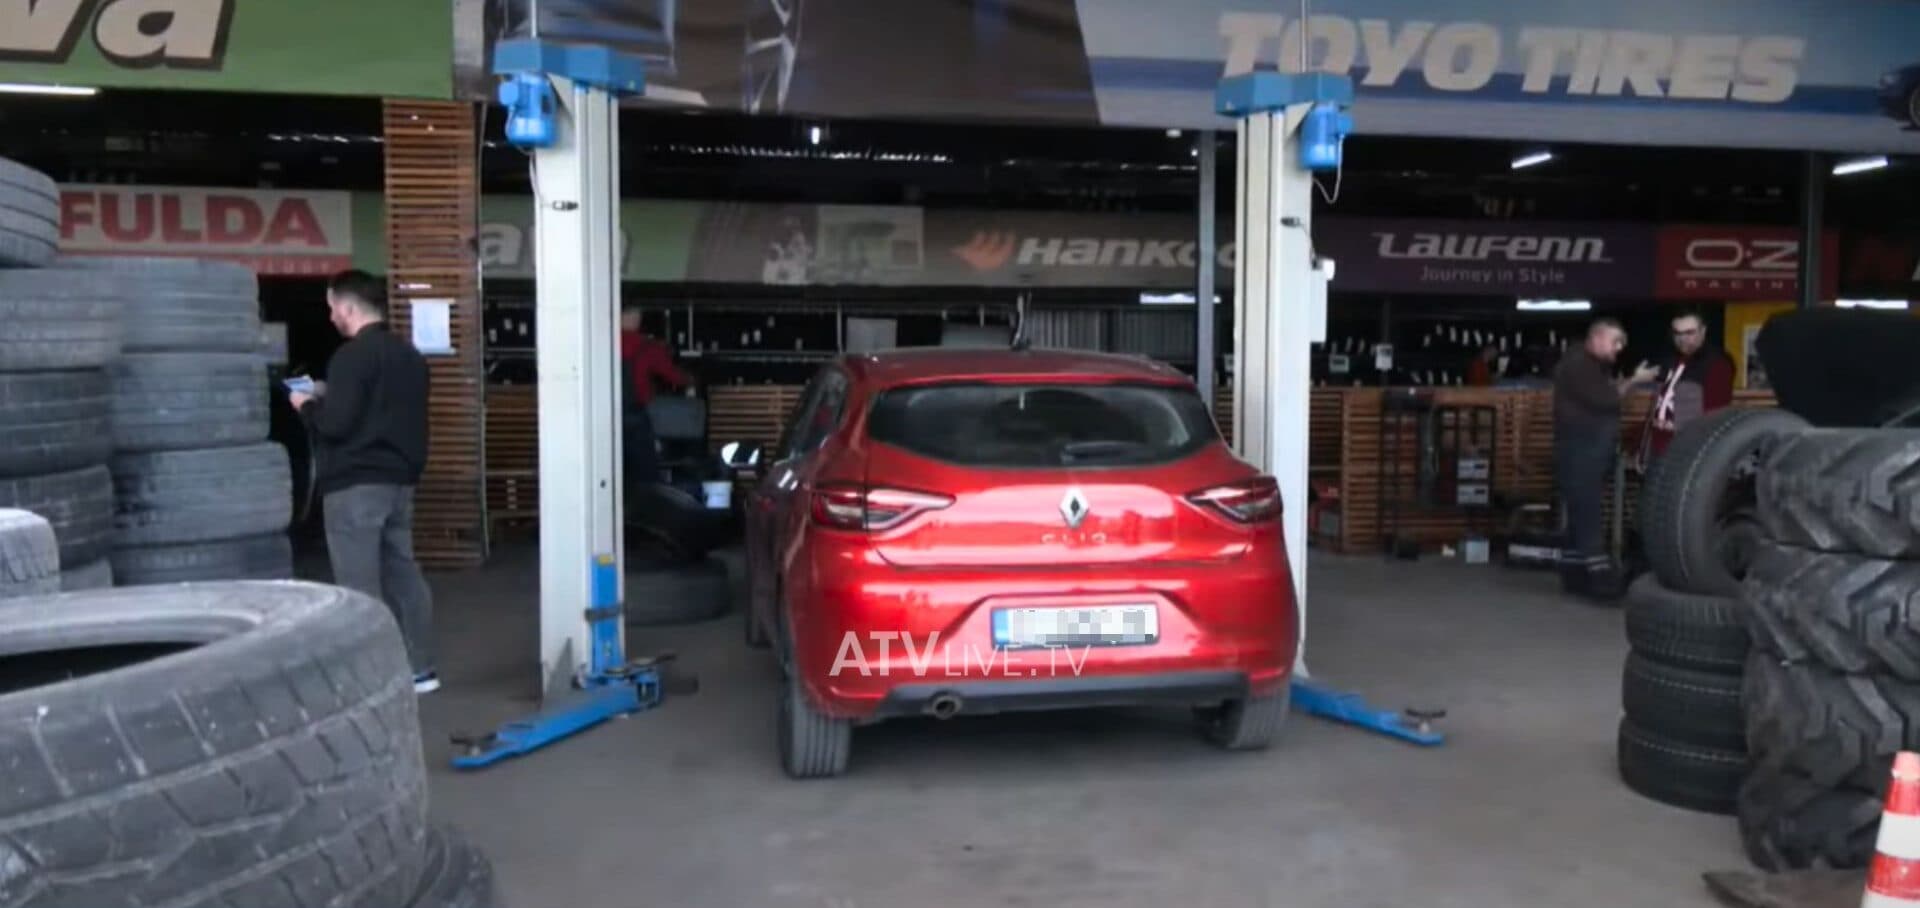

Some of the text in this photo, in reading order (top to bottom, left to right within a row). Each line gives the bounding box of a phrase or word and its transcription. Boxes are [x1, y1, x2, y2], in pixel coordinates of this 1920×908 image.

[1218, 11, 1807, 103] TOYO TIRES
[59, 190, 329, 247] FULDA
[1420, 266, 1565, 284] Journey in Style
[1683, 279, 1798, 289] RACIN
